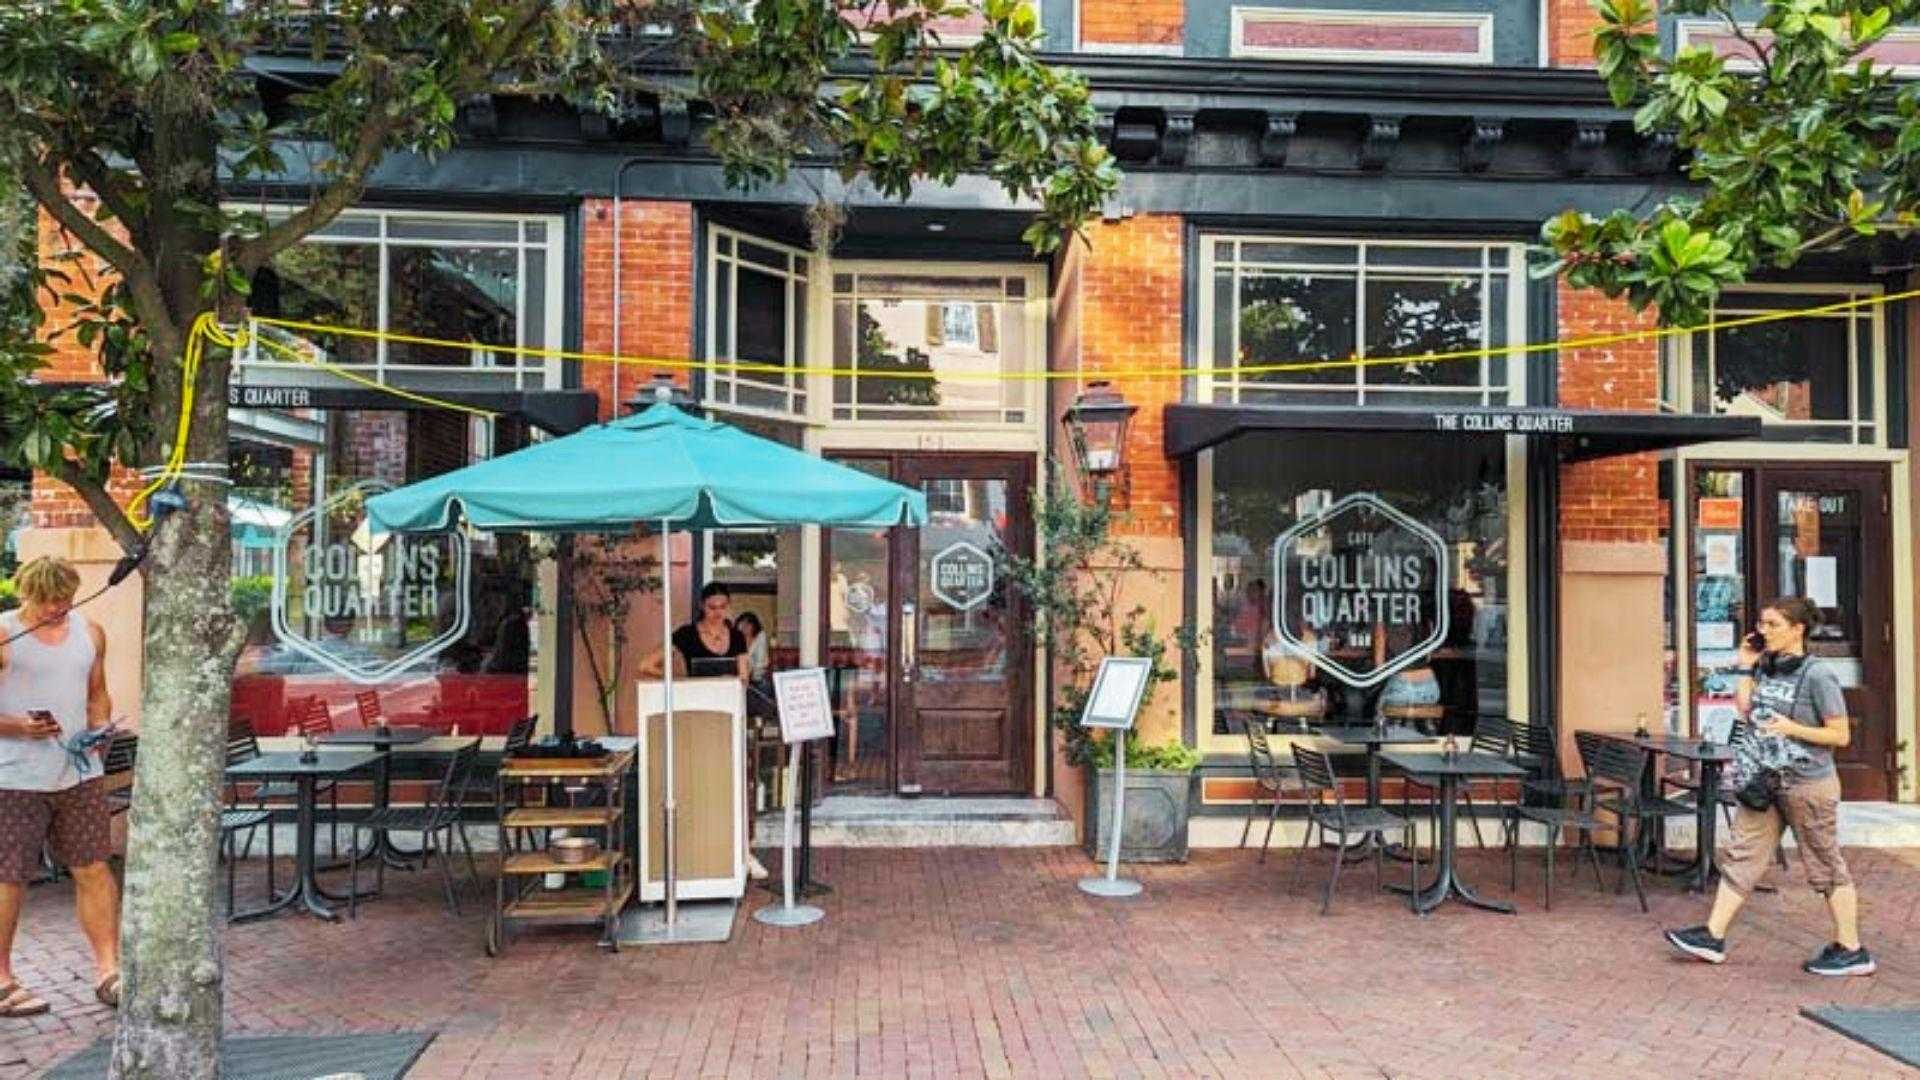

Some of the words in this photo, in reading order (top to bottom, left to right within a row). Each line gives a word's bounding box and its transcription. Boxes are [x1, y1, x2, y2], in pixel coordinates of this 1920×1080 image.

[244, 388, 309, 406] QUARTER
[1435, 414, 1457, 430] THE
[1462, 414, 1513, 431] COLLINS
[1516, 414, 1574, 432] QUARTER
[1820, 496, 1844, 513] OUT
[304, 542, 439, 581] COLINS
[1301, 554, 1421, 590] COLLINS
[304, 584, 438, 618] QUARTER
[1302, 591, 1421, 624] QUARTER
